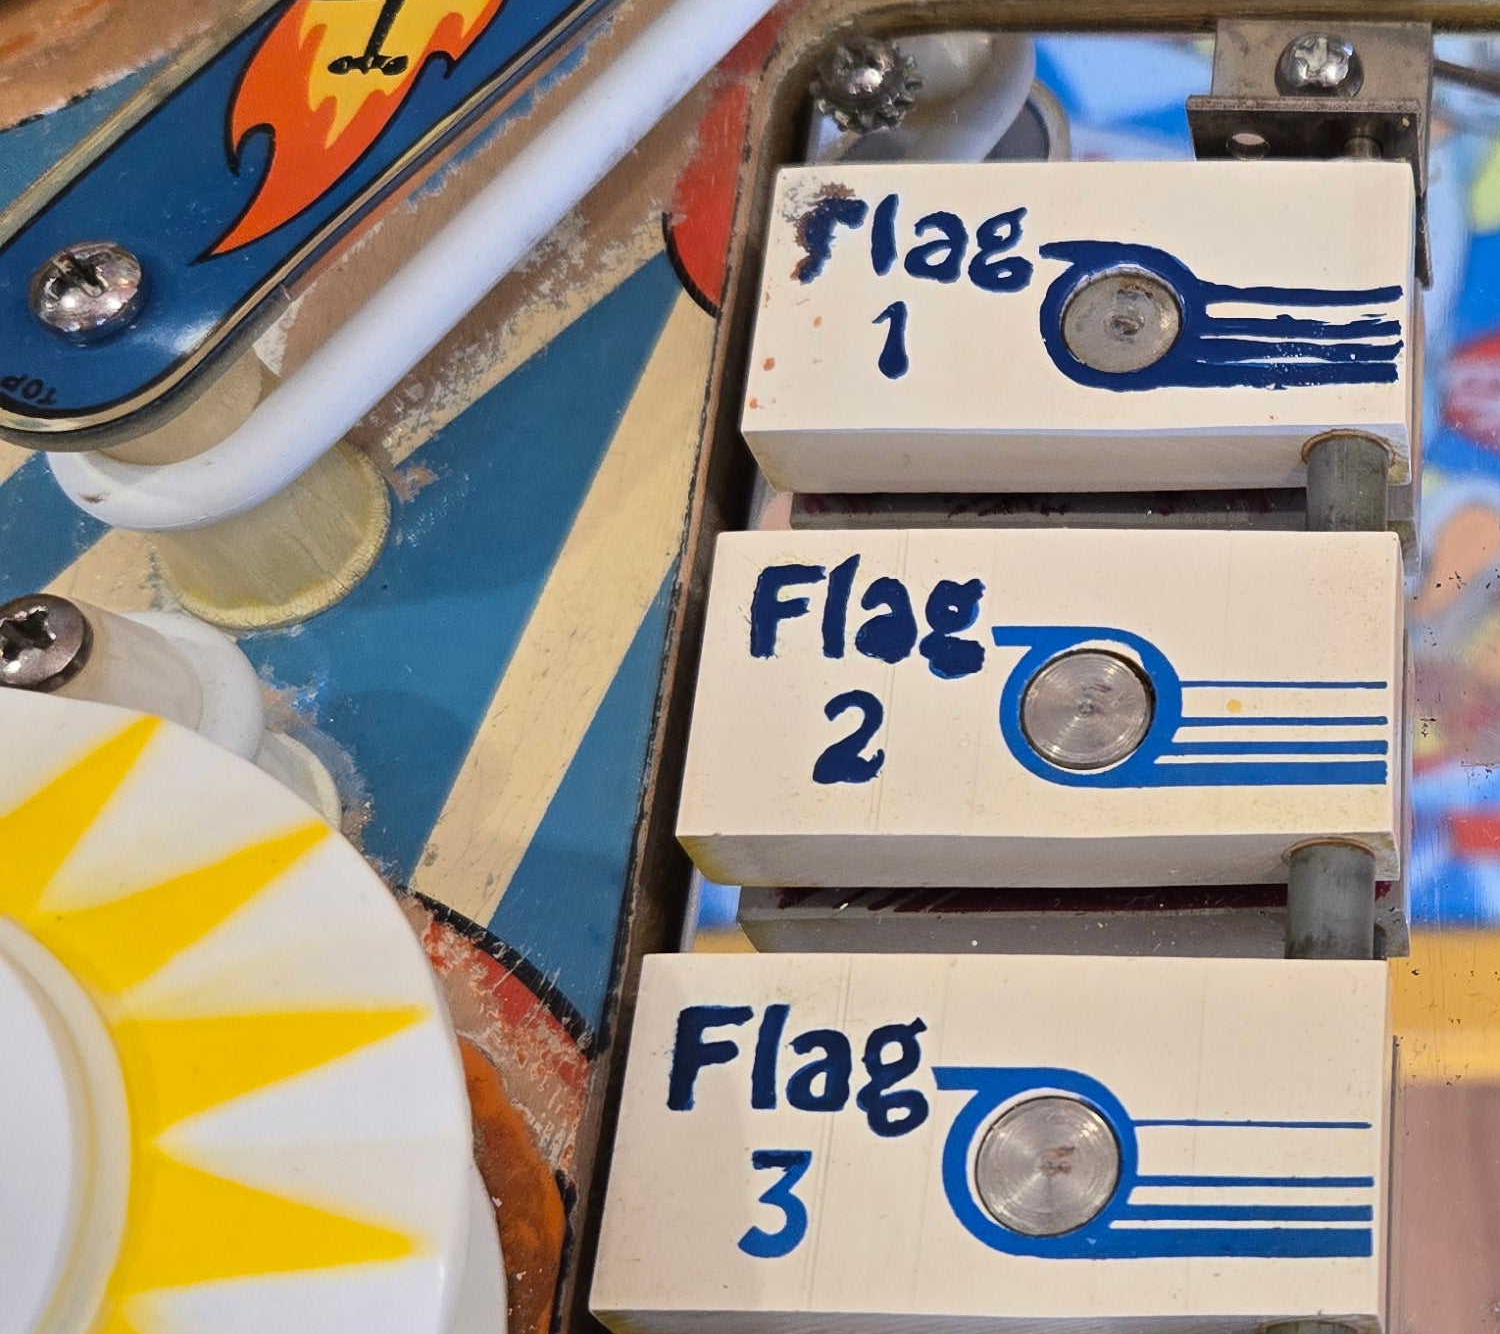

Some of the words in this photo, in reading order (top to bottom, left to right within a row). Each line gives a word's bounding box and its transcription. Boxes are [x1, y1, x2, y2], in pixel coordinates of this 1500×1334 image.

[792, 192, 1035, 294] Flag
[871, 300, 910, 381] 1
[749, 553, 987, 679] Flag
[812, 690, 886, 785] 2
[667, 1004, 931, 1139] Flag
[737, 1149, 813, 1259] 3
